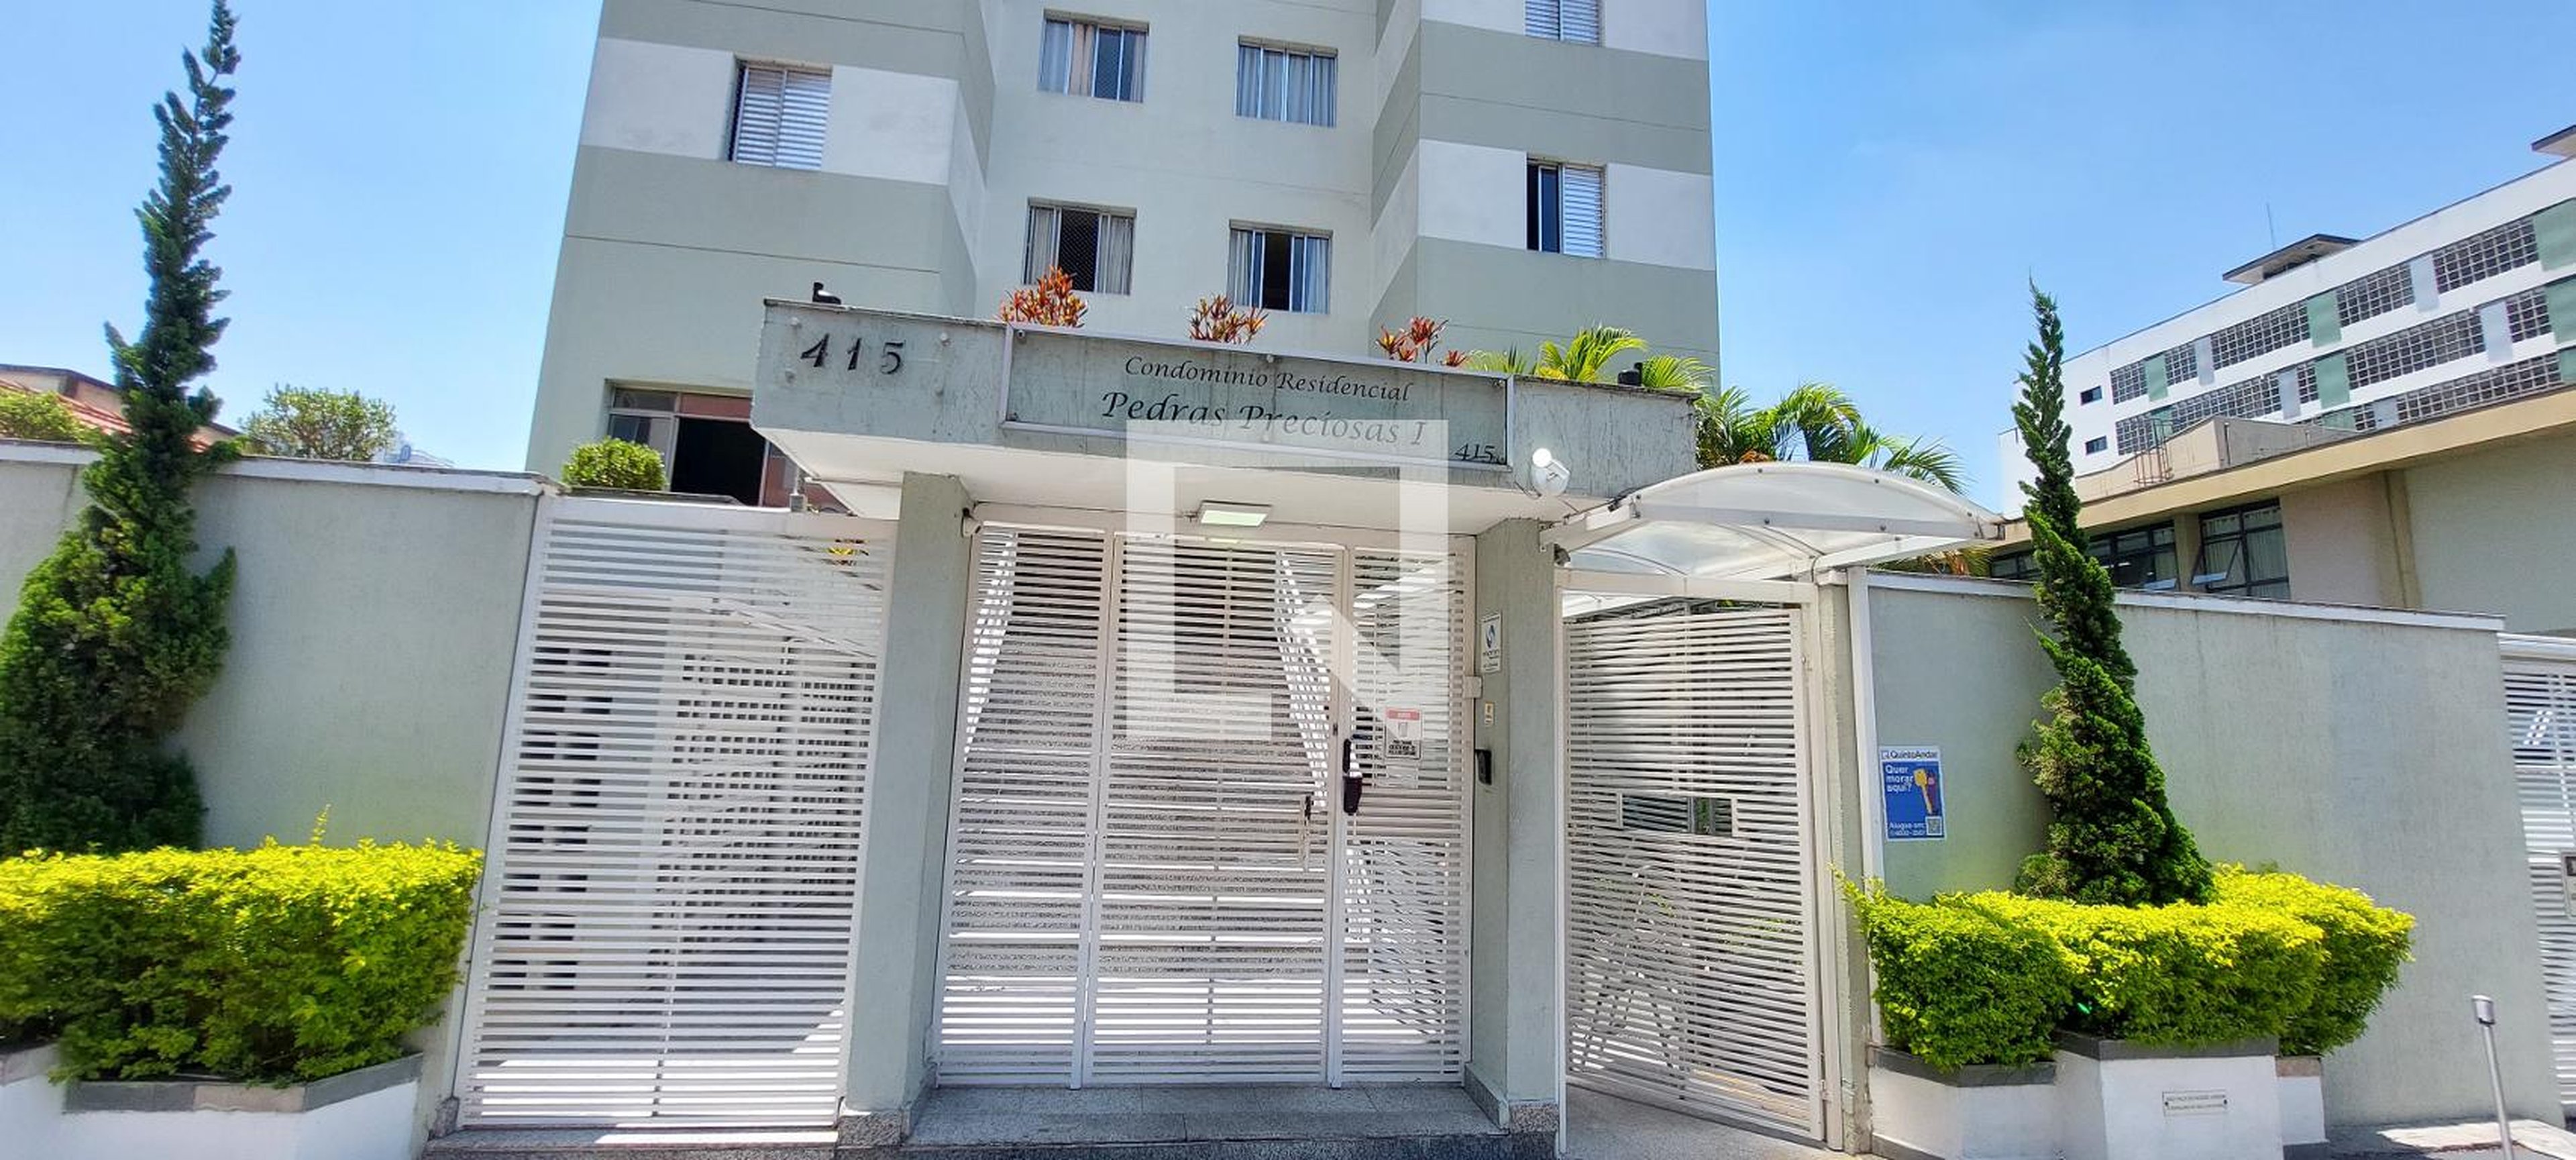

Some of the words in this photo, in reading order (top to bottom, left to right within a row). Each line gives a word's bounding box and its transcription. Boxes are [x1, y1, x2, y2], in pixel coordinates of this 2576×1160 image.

[800, 333, 904, 375] 415
[1277, 372, 1414, 401] Residencial
[1102, 392, 1226, 427] Pedras
[1240, 405, 1399, 443] Preciosas
[1455, 443, 1495, 462] 415
[1885, 764, 1909, 774] Quer
[1886, 776, 1913, 784] morar
